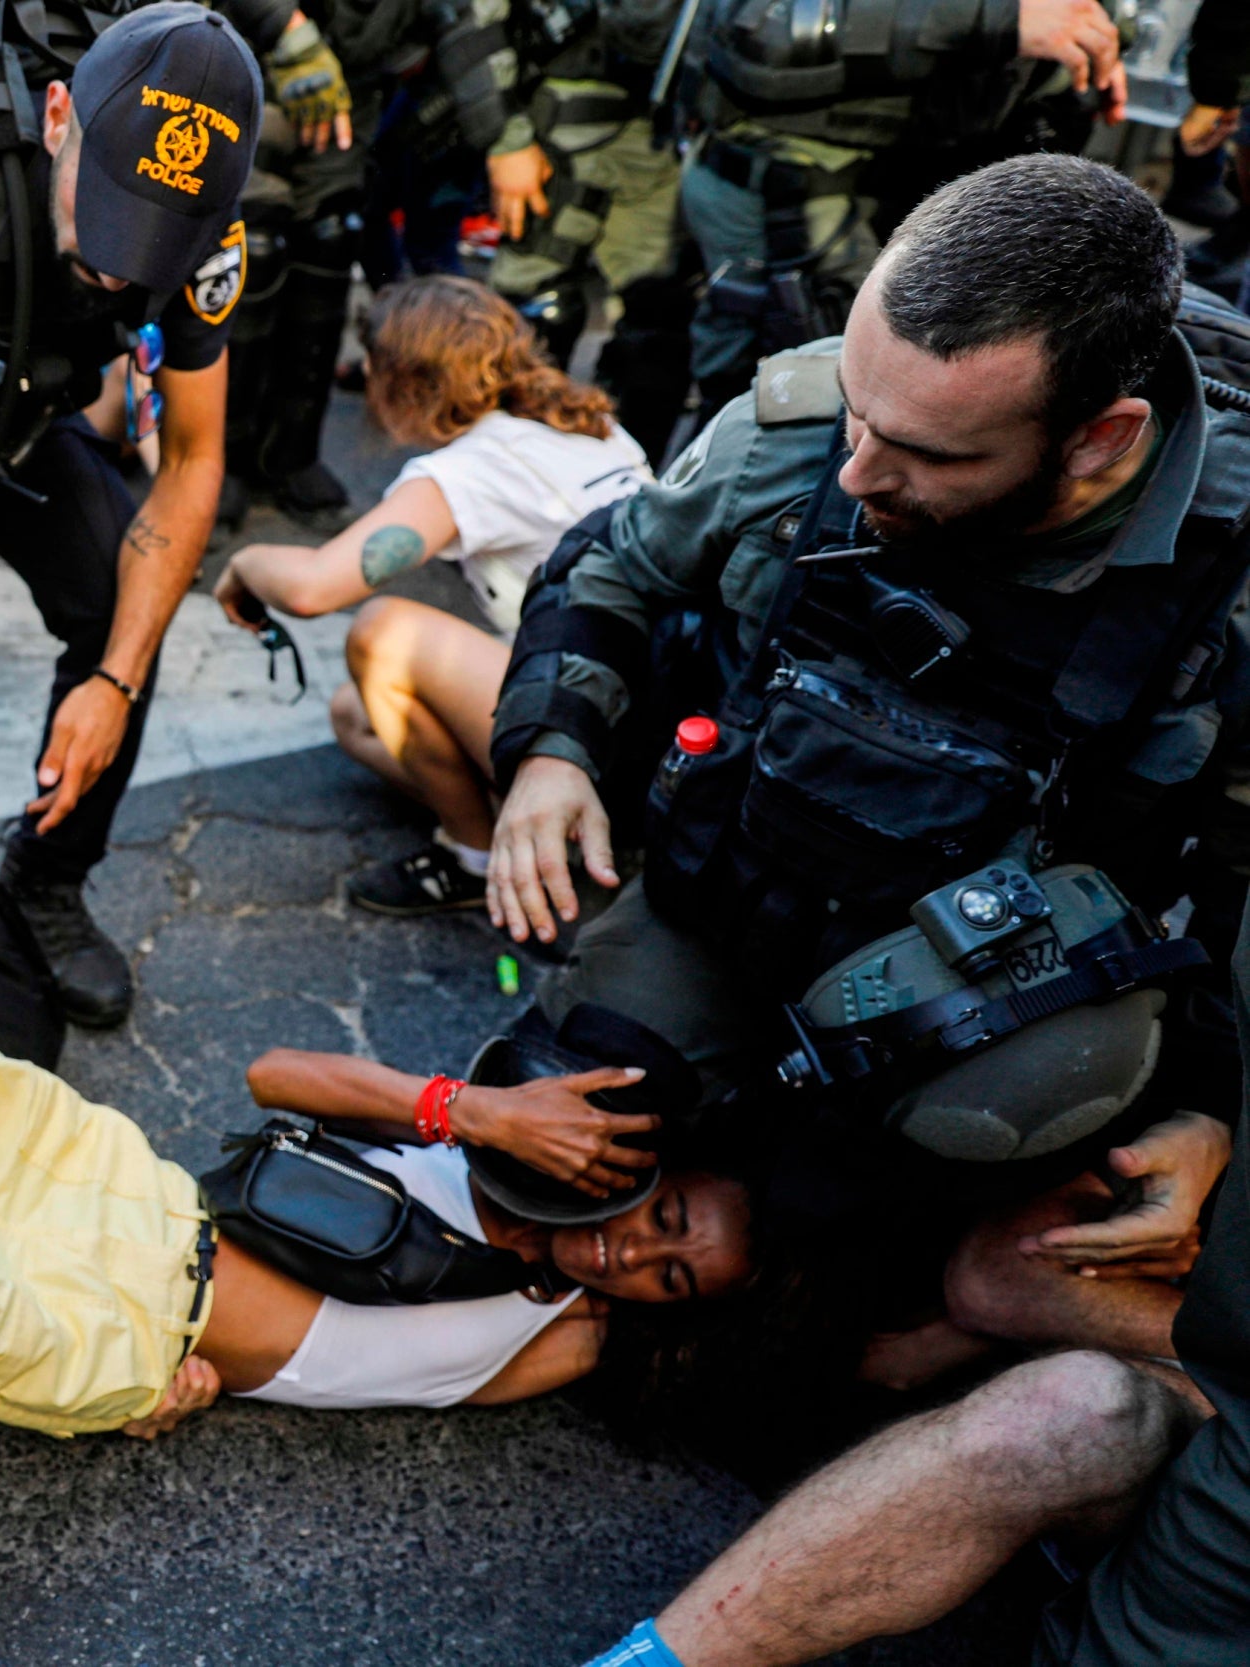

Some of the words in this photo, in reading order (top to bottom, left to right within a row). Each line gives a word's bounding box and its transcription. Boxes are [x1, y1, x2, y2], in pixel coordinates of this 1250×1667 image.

[141, 85, 191, 112] ישראל
[191, 103, 240, 143] משטרת
[136, 157, 204, 195] POLICE
